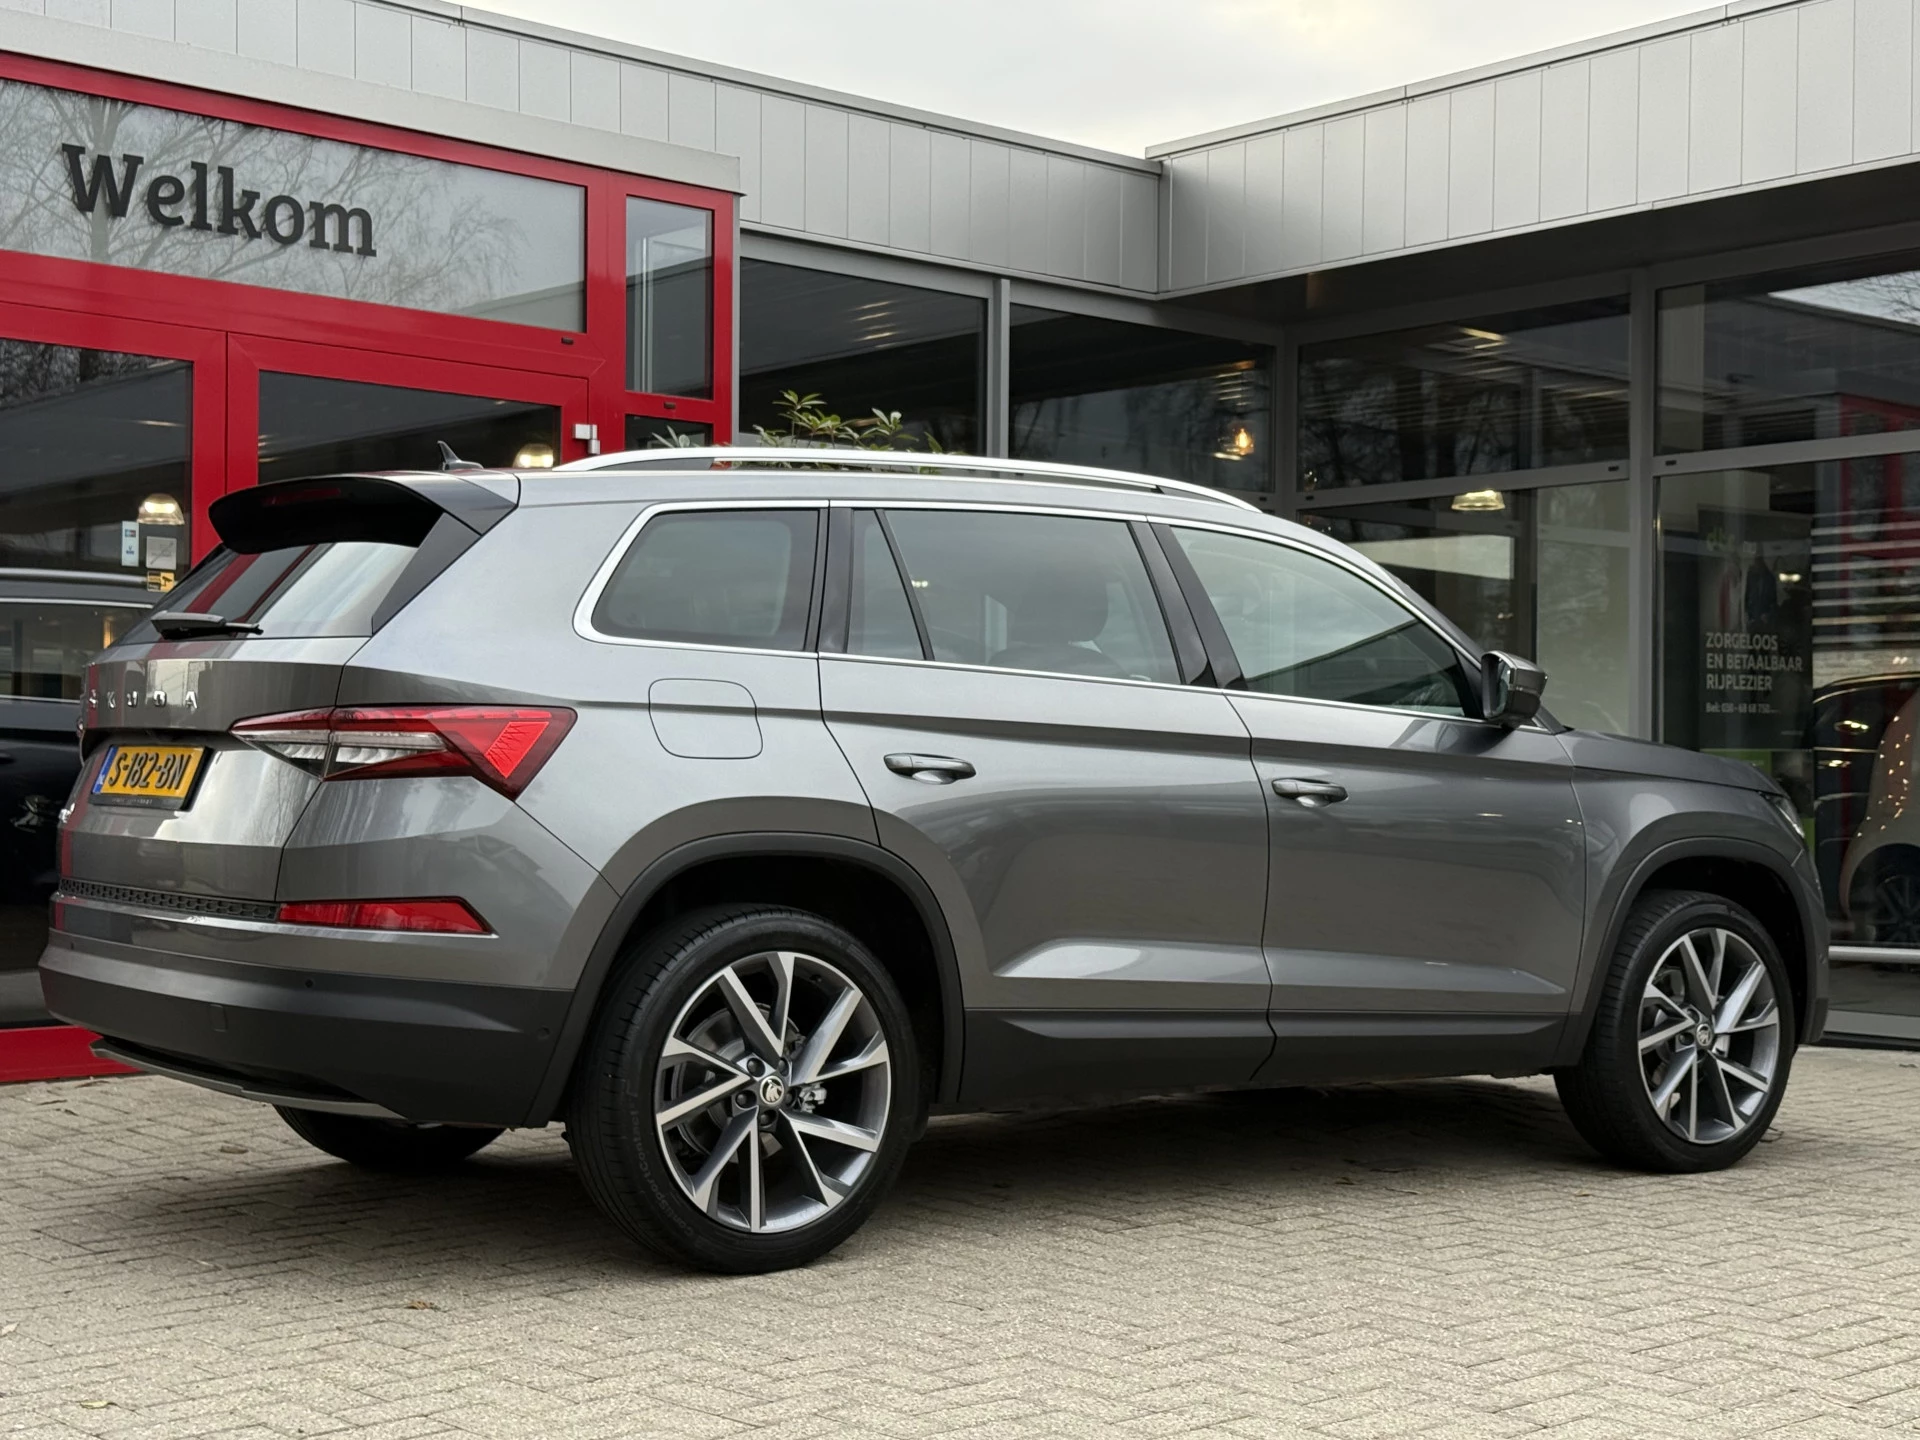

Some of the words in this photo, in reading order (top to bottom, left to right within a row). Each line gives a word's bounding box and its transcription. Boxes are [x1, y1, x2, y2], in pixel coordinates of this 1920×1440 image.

[62, 143, 377, 257] Welkom
[1705, 632, 1779, 651] ZORGELOOS
[1706, 653, 1723, 669] EN
[1726, 654, 1803, 672] BETAALBAAR
[1706, 674, 1773, 691] RIJPLEZIER
[107, 752, 192, 790] S-182-BN
